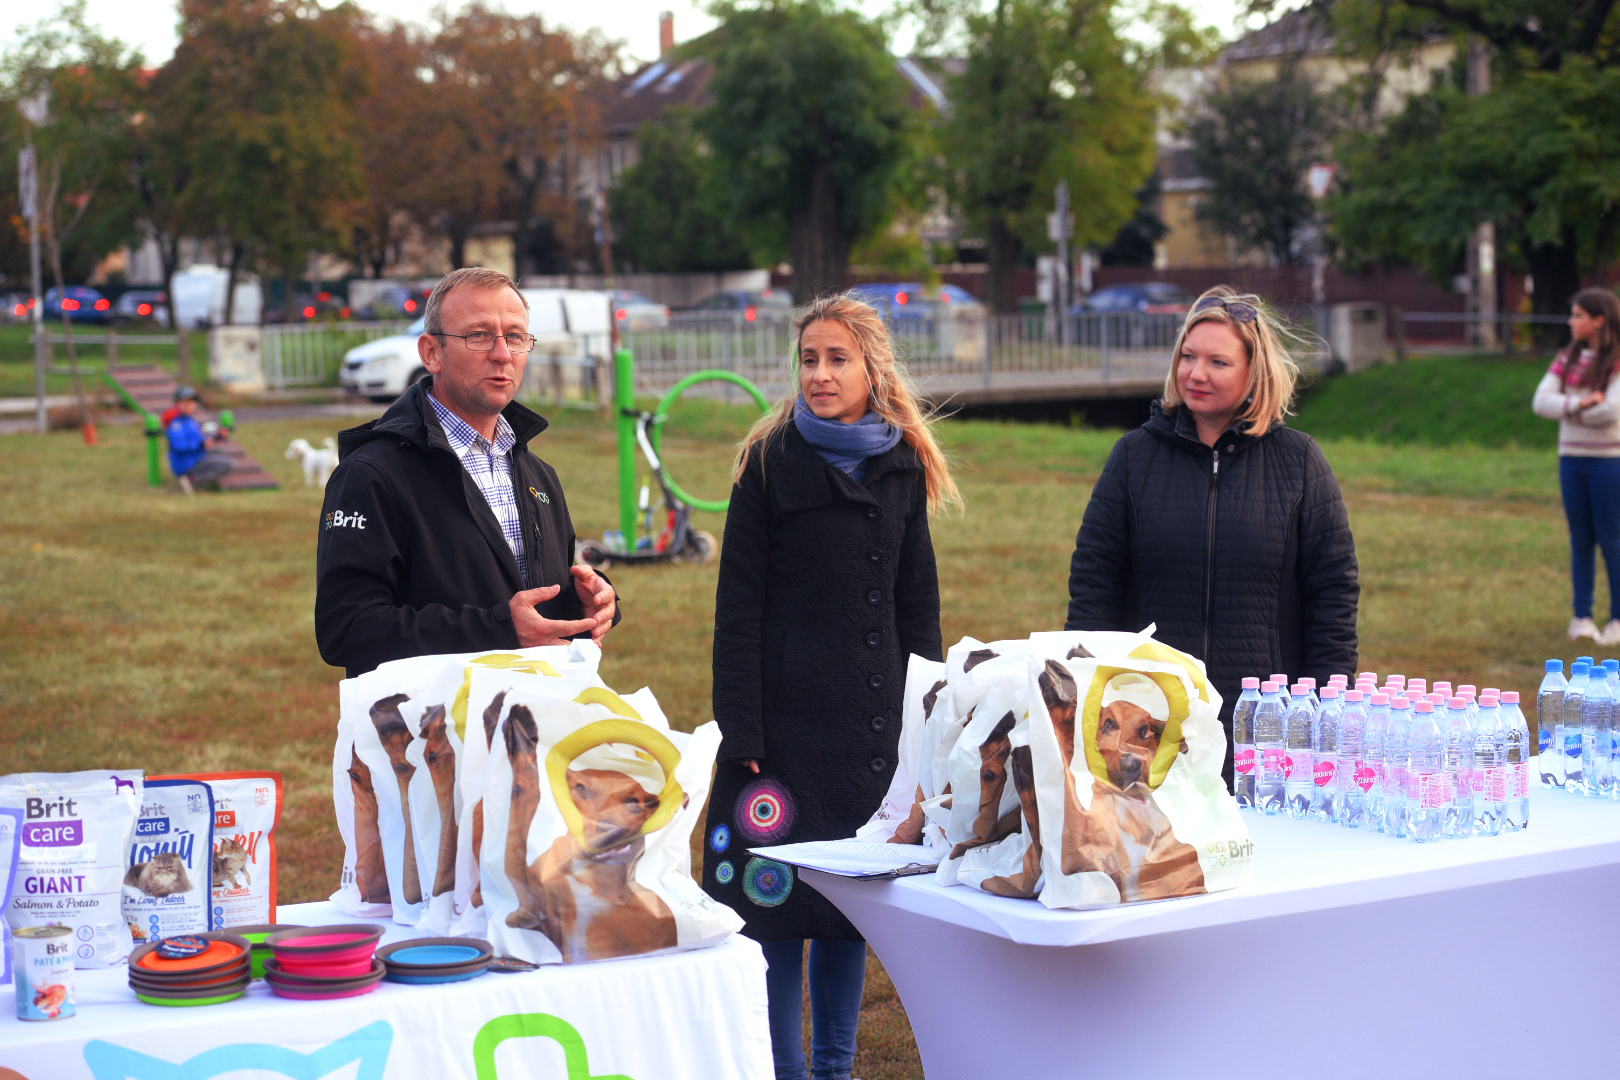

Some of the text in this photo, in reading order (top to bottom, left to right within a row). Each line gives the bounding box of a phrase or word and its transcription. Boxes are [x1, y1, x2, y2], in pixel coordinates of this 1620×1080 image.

[334, 510, 367, 529] Brit
[26, 796, 78, 819] Brit
[30, 826, 75, 843] care
[137, 821, 166, 833] care
[1228, 838, 1254, 858] Brit
[24, 875, 86, 894] GIANT
[13, 897, 100, 909] Salmon & Potato
[46, 942, 69, 955] Brit
